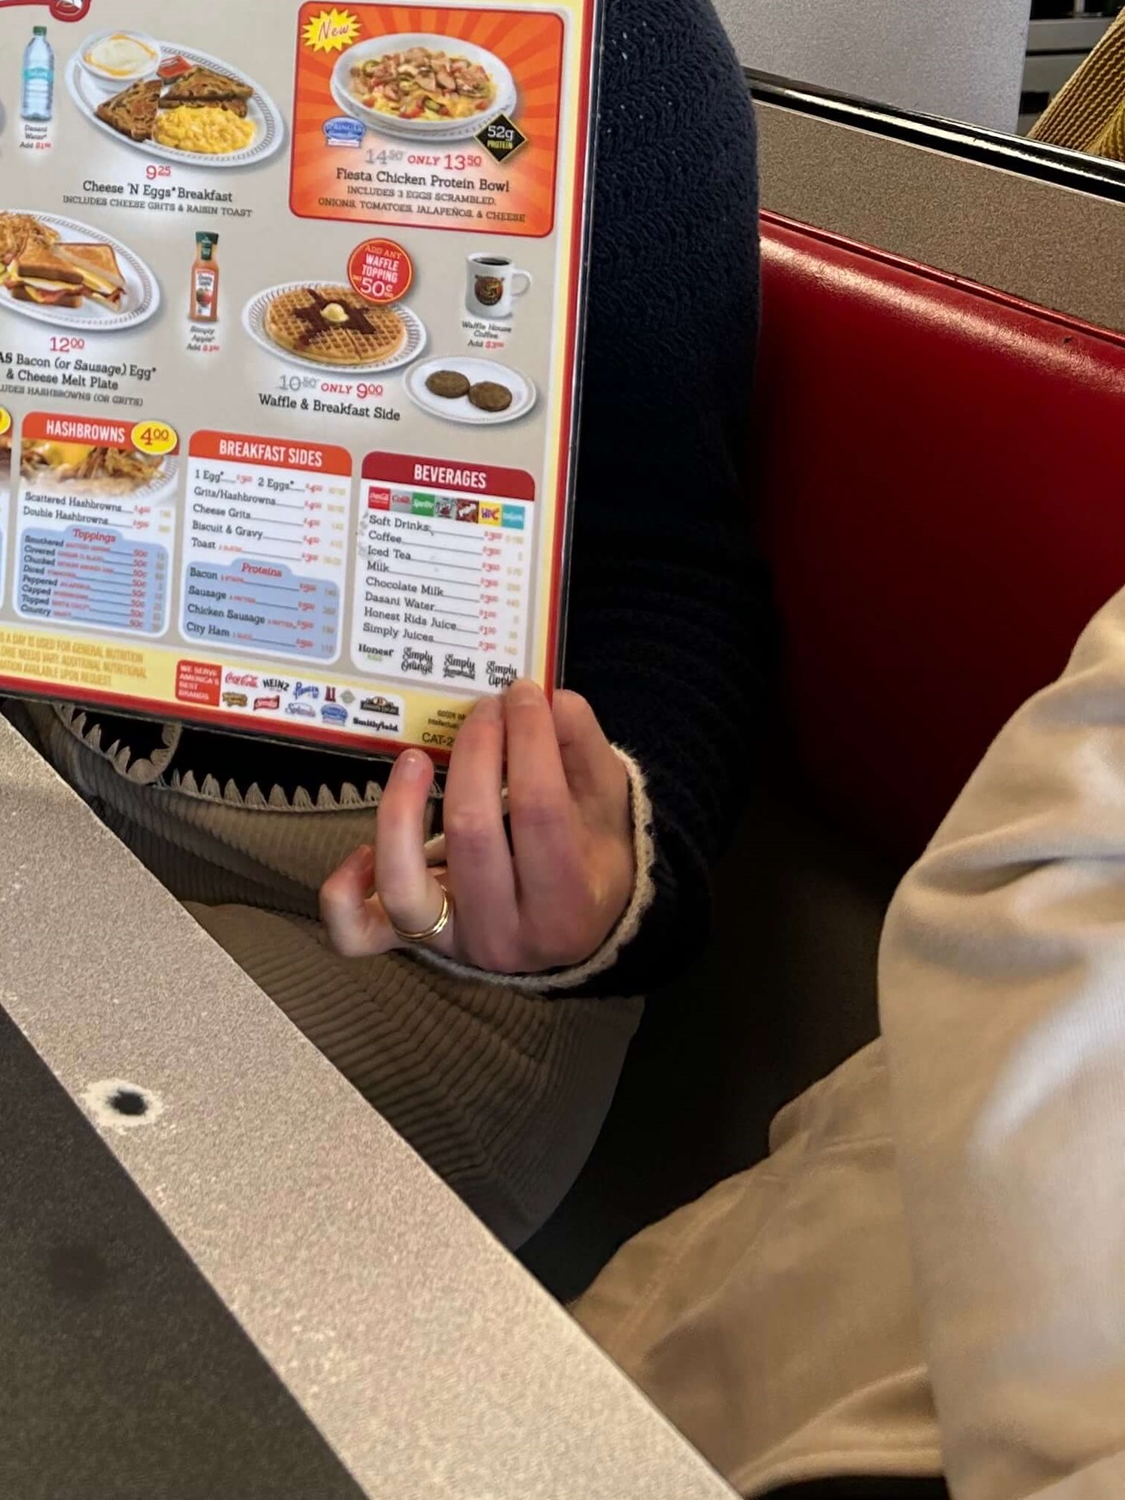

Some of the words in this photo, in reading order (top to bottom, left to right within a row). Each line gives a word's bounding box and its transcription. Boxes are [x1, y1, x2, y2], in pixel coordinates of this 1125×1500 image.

[318, 18, 349, 42] New
[486, 124, 515, 141] 52g
[407, 154, 440, 166] ONLY
[335, 167, 373, 182] Fiesta
[376, 170, 426, 186] Chicken
[430, 174, 475, 190] Protein
[478, 178, 510, 193] Bowl
[82, 180, 124, 194] Cheese
[177, 187, 232, 202] Breakfast
[364, 253, 399, 272] WAFFLE
[361, 264, 398, 283] TOPPING
[16, 354, 50, 368] Bacon
[53, 357, 70, 371] (or
[73, 359, 127, 378] Sausage)
[5, 369, 14, 380] &
[17, 369, 58, 385] Cheese
[61, 373, 87, 388] Melt
[89, 376, 118, 391] Plate
[320, 382, 352, 395] ONLY
[258, 393, 297, 409] Waffle
[300, 398, 309, 410] &
[312, 399, 370, 417] Breakfast
[373, 405, 401, 421] Side
[46, 419, 125, 443] HASHBROWNS
[218, 439, 287, 463] BREAKFAST
[288, 447, 323, 467] SIDES
[413, 463, 487, 489] BEVERAGES
[24, 491, 66, 506] Scattered
[69, 496, 122, 512] Hashbrowns
[193, 486, 276, 506] Grits/Hashbrowns
[23, 505, 53, 519] Double
[55, 509, 108, 525] Hashbrowns
[368, 514, 392, 527] Soft
[394, 517, 430, 532] Drinks
[72, 527, 116, 544] Toppings
[191, 537, 216, 549] Toast
[368, 530, 402, 544] Coffee
[367, 545, 389, 558] Iced
[392, 548, 412, 561] Tea
[189, 568, 218, 581] Bacon
[240, 562, 283, 578] Proteins
[366, 560, 390, 573] Milk
[187, 585, 227, 602] Sausage
[365, 576, 418, 594] Chocolate
[420, 584, 444, 597] Milk
[421, 731, 455, 747] CAT-2
